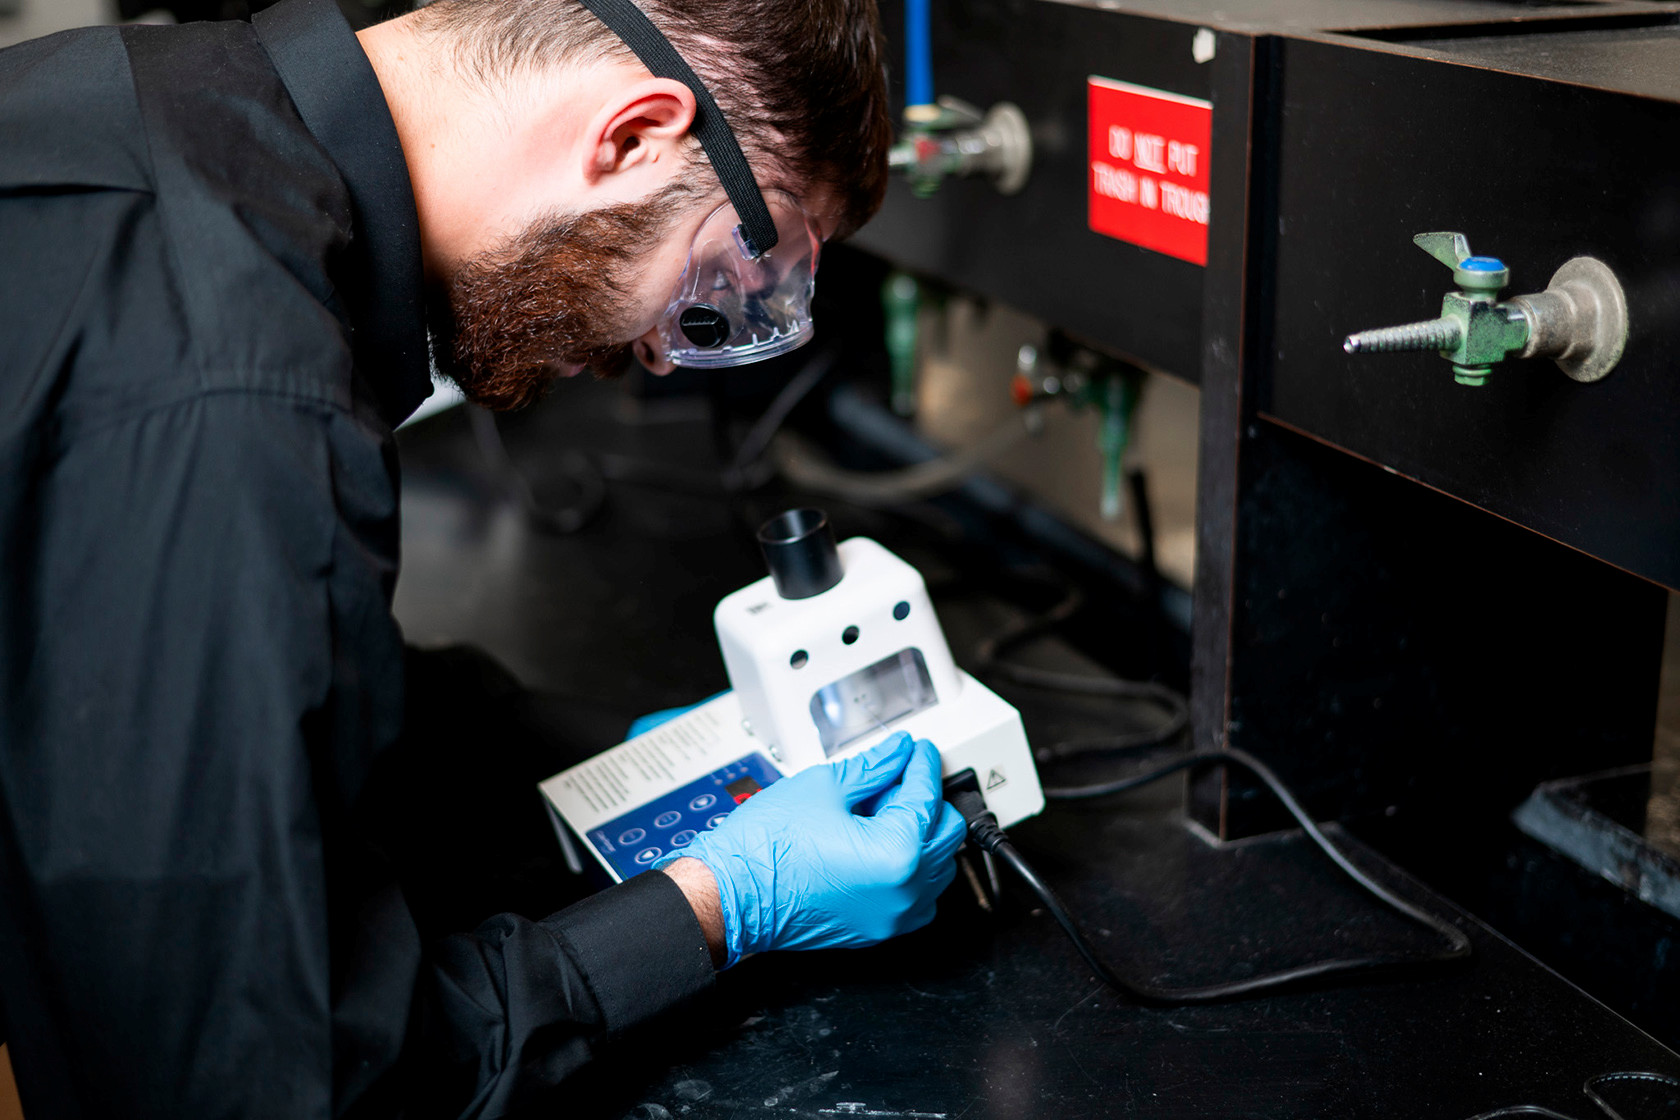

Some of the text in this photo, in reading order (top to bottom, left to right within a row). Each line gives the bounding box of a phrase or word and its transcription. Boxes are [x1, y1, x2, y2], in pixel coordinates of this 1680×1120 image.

[1109, 125, 1199, 177] DO NOT PUT
[1091, 160, 1210, 225] TRASH IN TROUG
